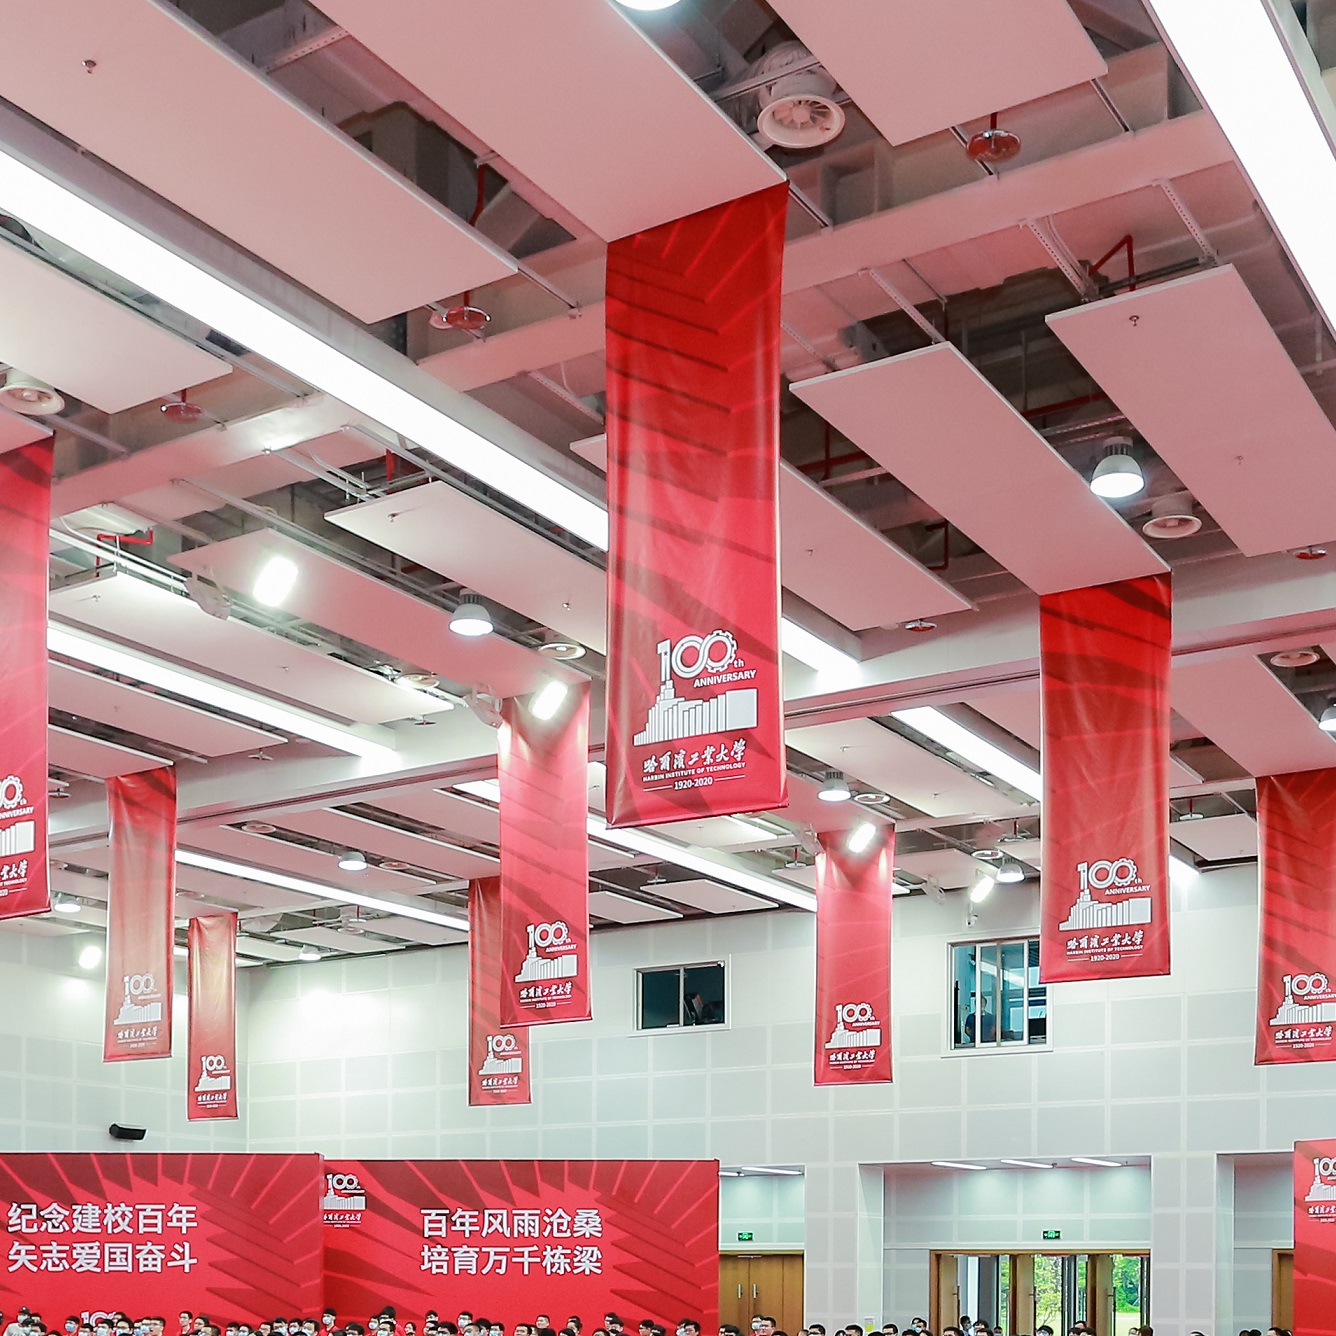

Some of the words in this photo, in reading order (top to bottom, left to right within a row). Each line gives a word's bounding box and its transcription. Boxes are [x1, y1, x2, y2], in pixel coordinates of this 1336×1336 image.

[694, 669, 757, 688] ANNIVERSARY
[674, 777, 713, 790] 1920-2020
[1105, 885, 1151, 895] ANNIVERSARY
[7, 1203, 198, 1234] 纪念建校百年
[420, 1208, 603, 1238] 百年风雨沧桑
[7, 1241, 198, 1273] 矢志爱国奋斗
[420, 1245, 603, 1275] 培育万千栋梁
